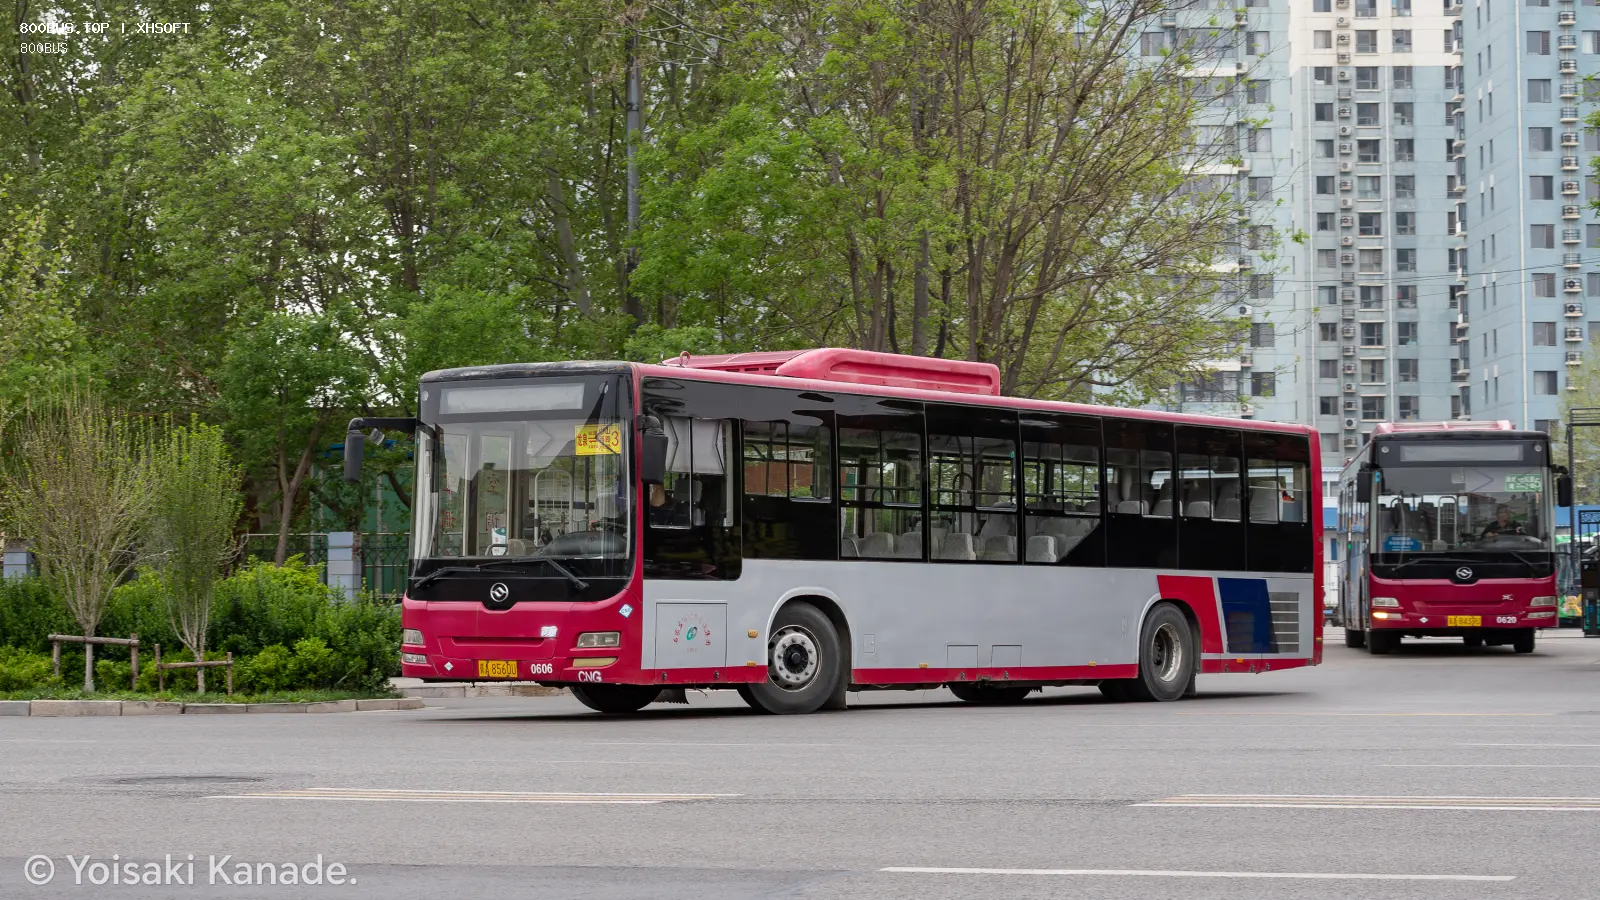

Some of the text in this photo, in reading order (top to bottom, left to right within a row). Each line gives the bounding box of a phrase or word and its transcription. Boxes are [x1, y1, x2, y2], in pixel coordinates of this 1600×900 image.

[1496, 616, 1517, 624] 0620
[530, 663, 553, 674] 0606
[577, 670, 602, 682] CNG
